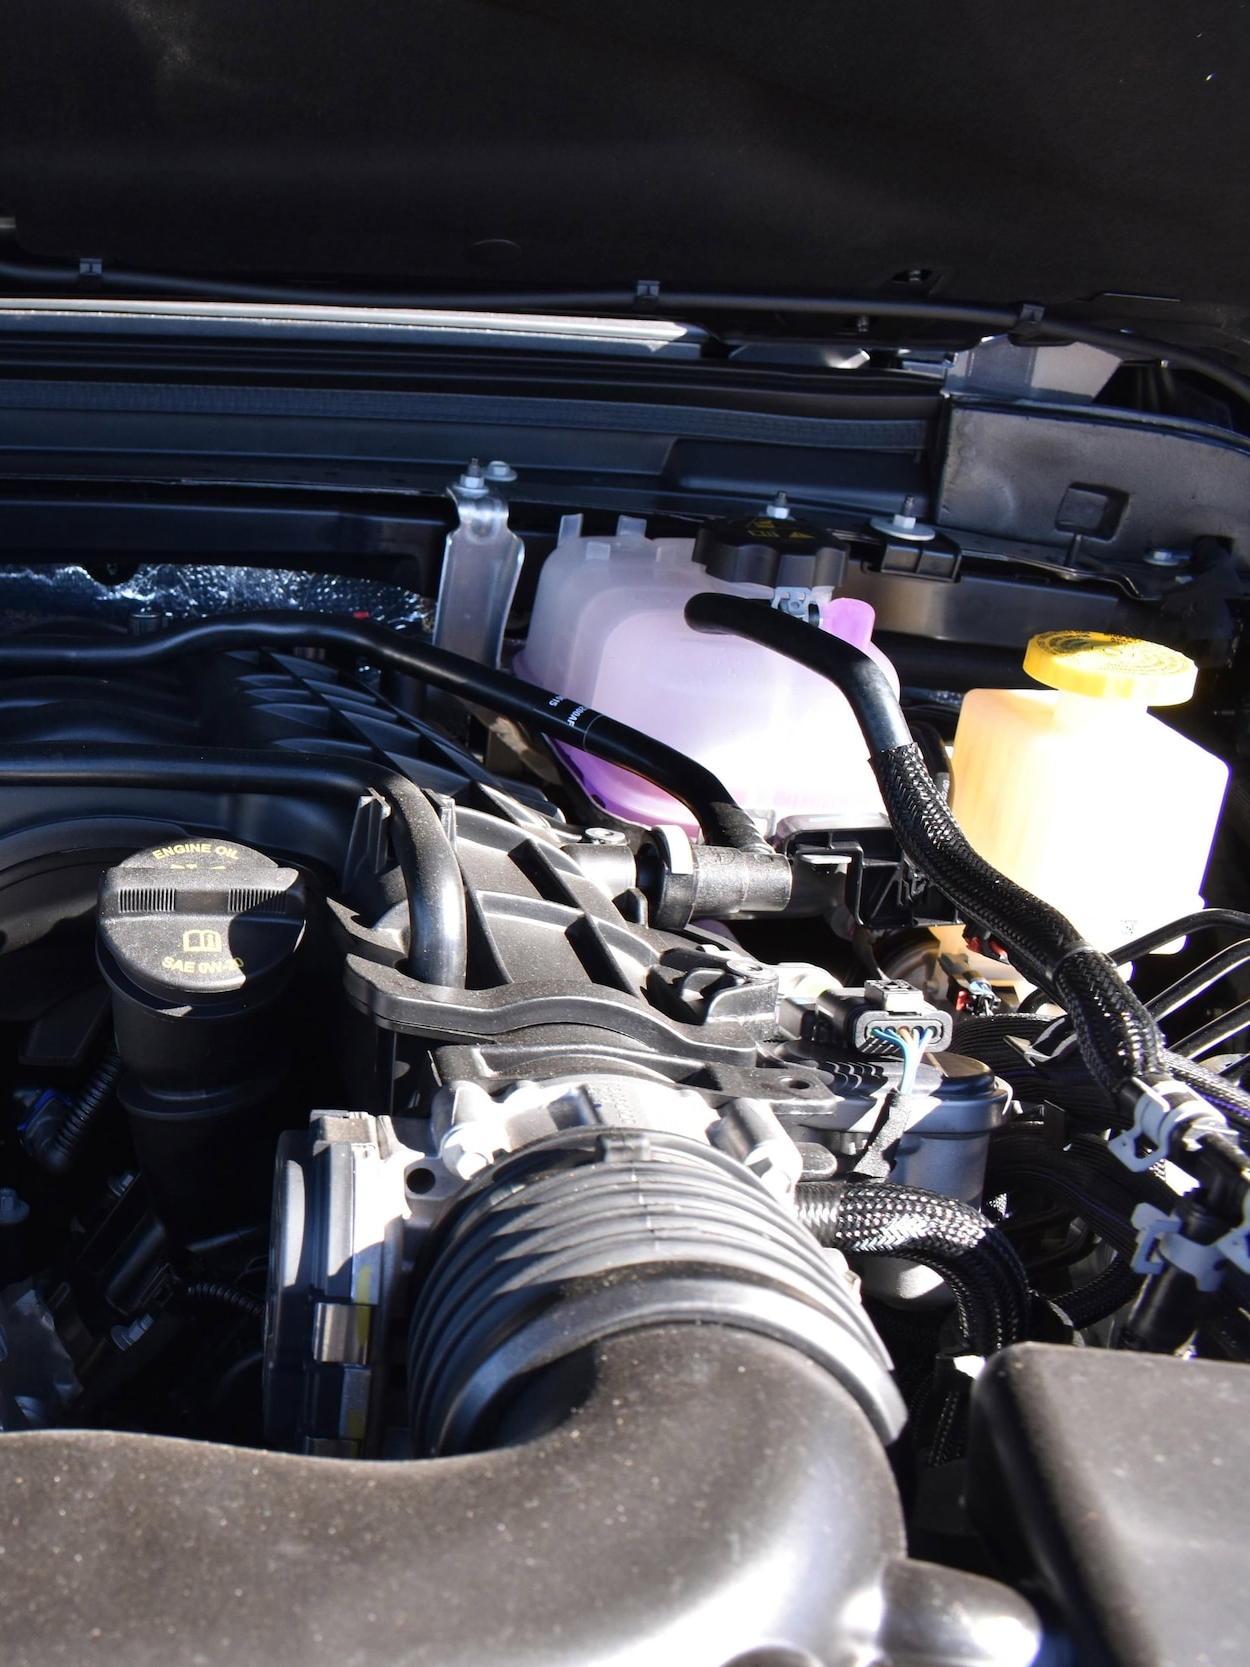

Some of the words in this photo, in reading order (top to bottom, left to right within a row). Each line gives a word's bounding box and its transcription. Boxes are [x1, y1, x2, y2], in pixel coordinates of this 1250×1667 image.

[152, 843, 212, 860] ENGINE
[215, 845, 239, 860] OIL
[162, 956, 196, 974] SAE
